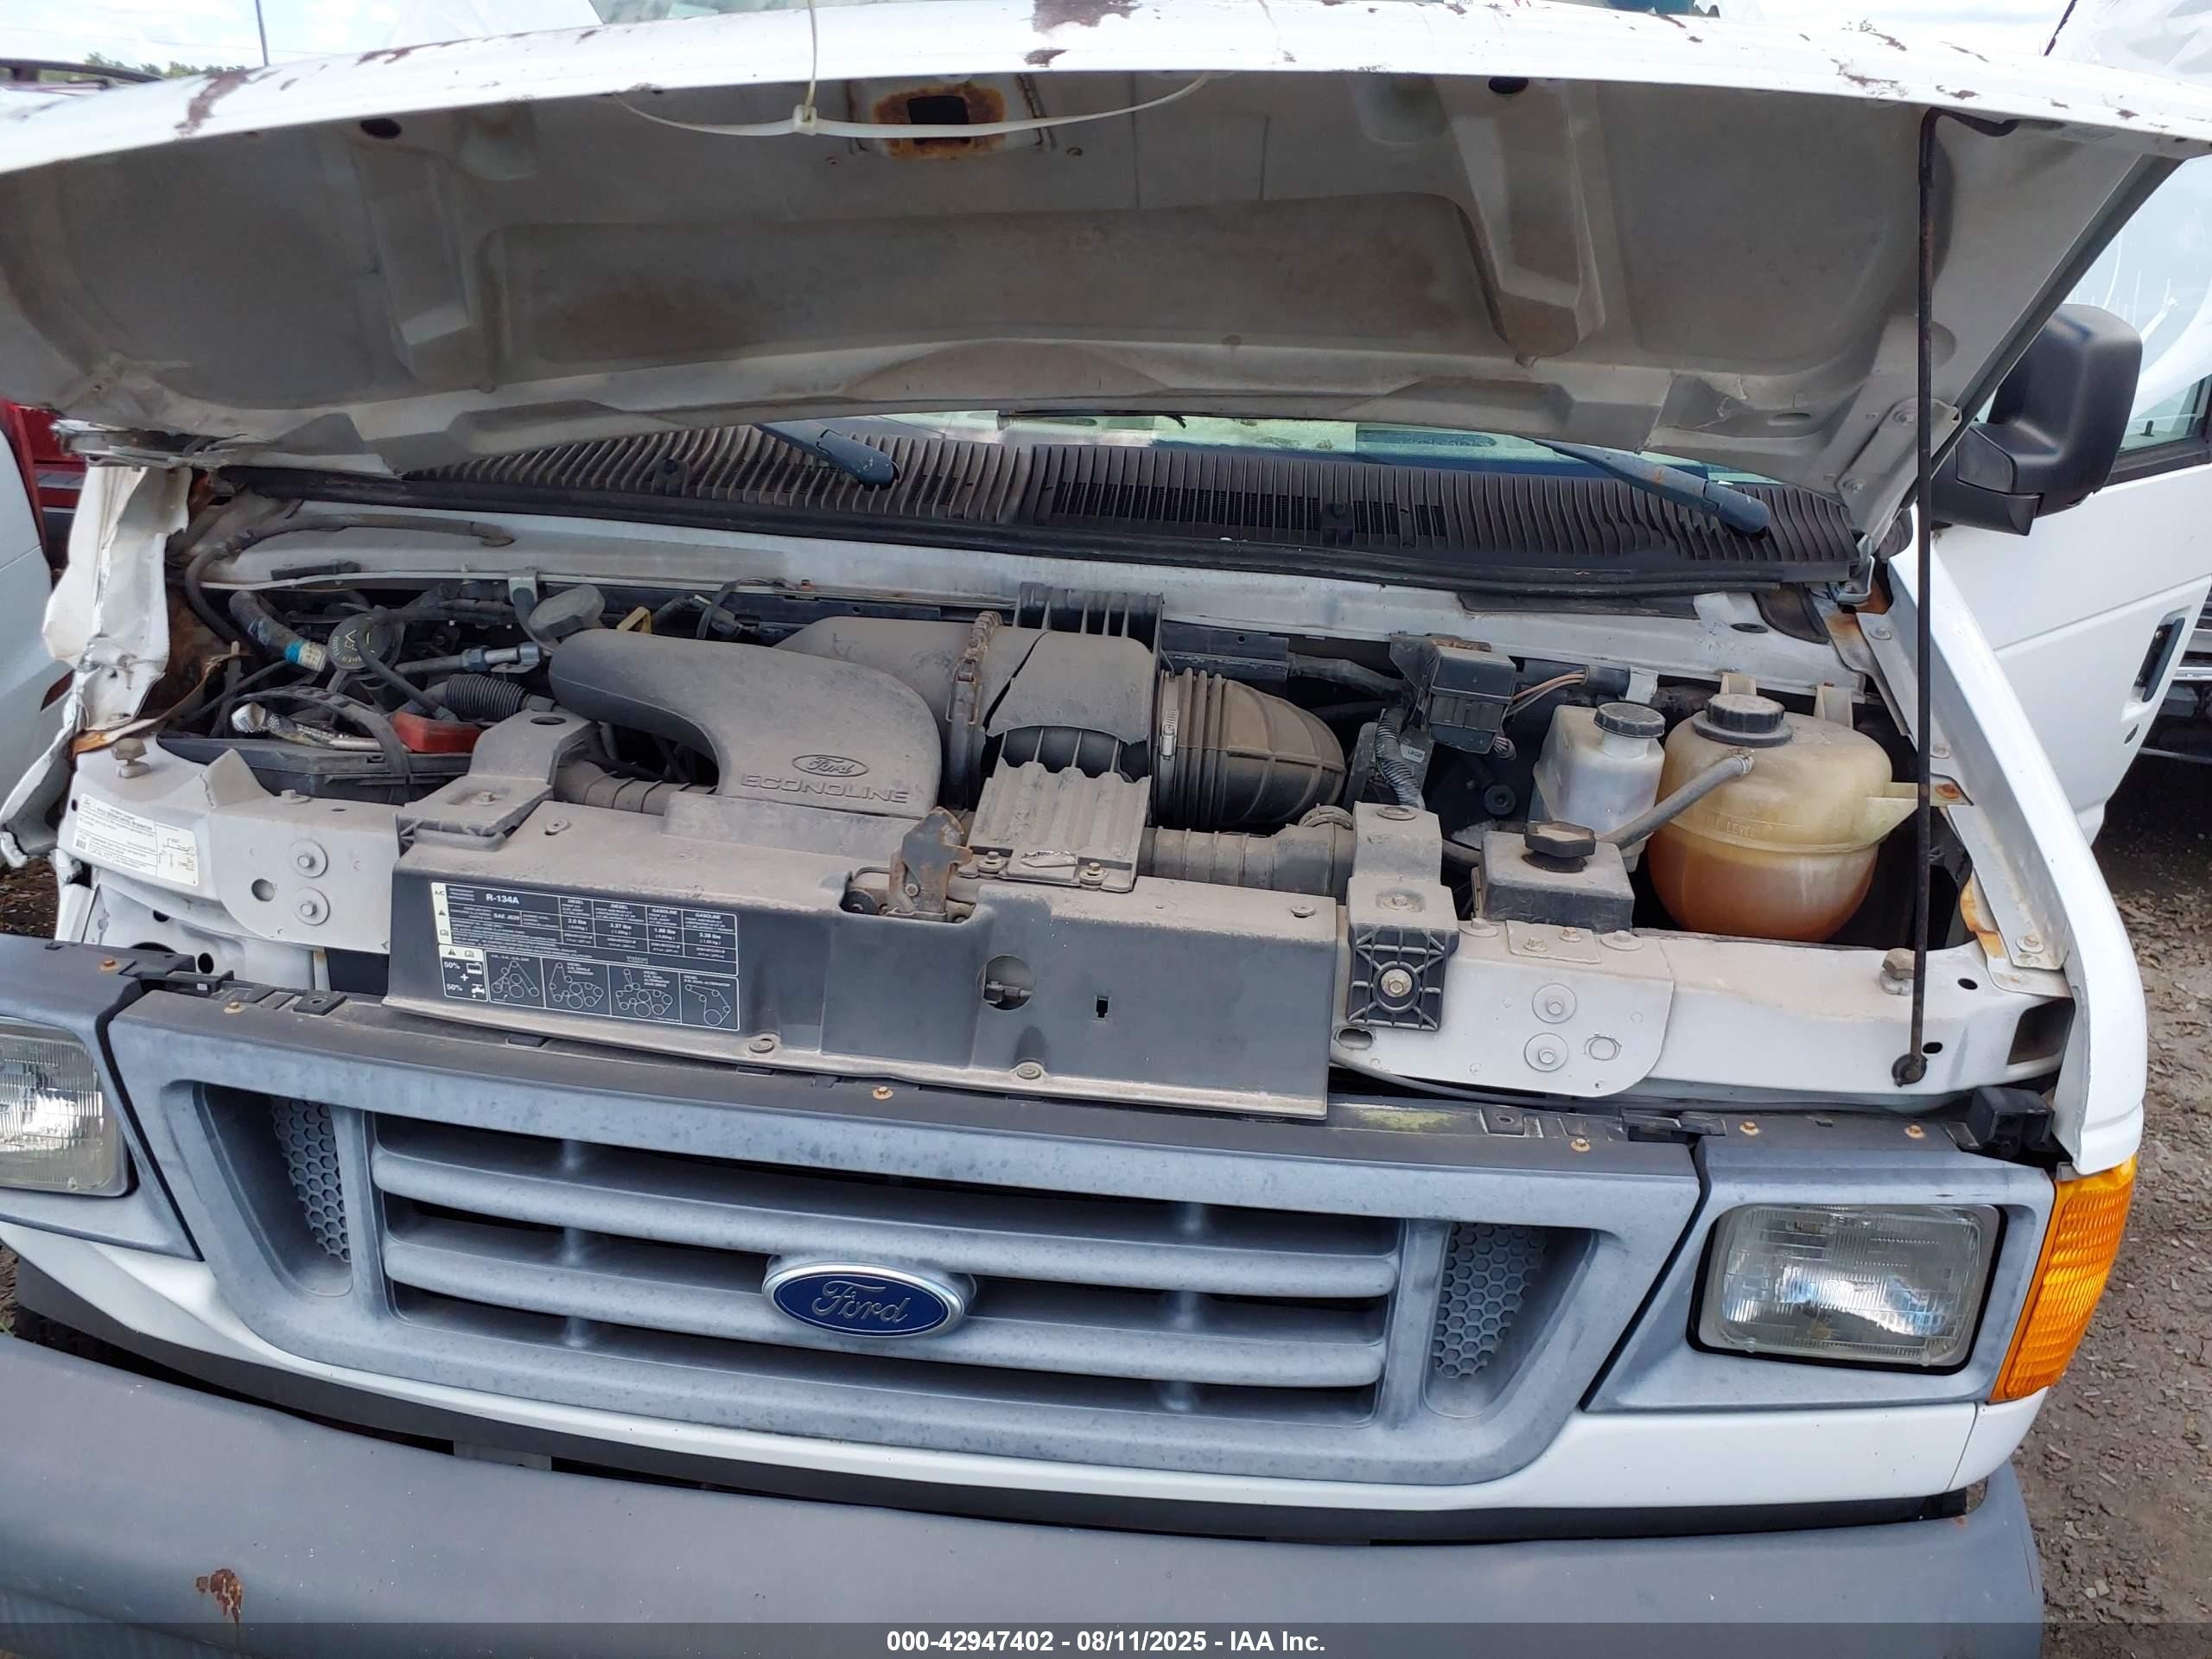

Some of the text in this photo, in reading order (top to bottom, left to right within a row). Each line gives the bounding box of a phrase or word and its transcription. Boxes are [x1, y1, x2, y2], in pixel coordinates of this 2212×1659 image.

[809, 756, 855, 775] Ford
[741, 774, 909, 804] ECONOLINE
[486, 893, 520, 905] R-134A
[444, 961, 461, 970] 50%
[447, 983, 464, 992] 50%
[811, 1280, 912, 1324] Ford
